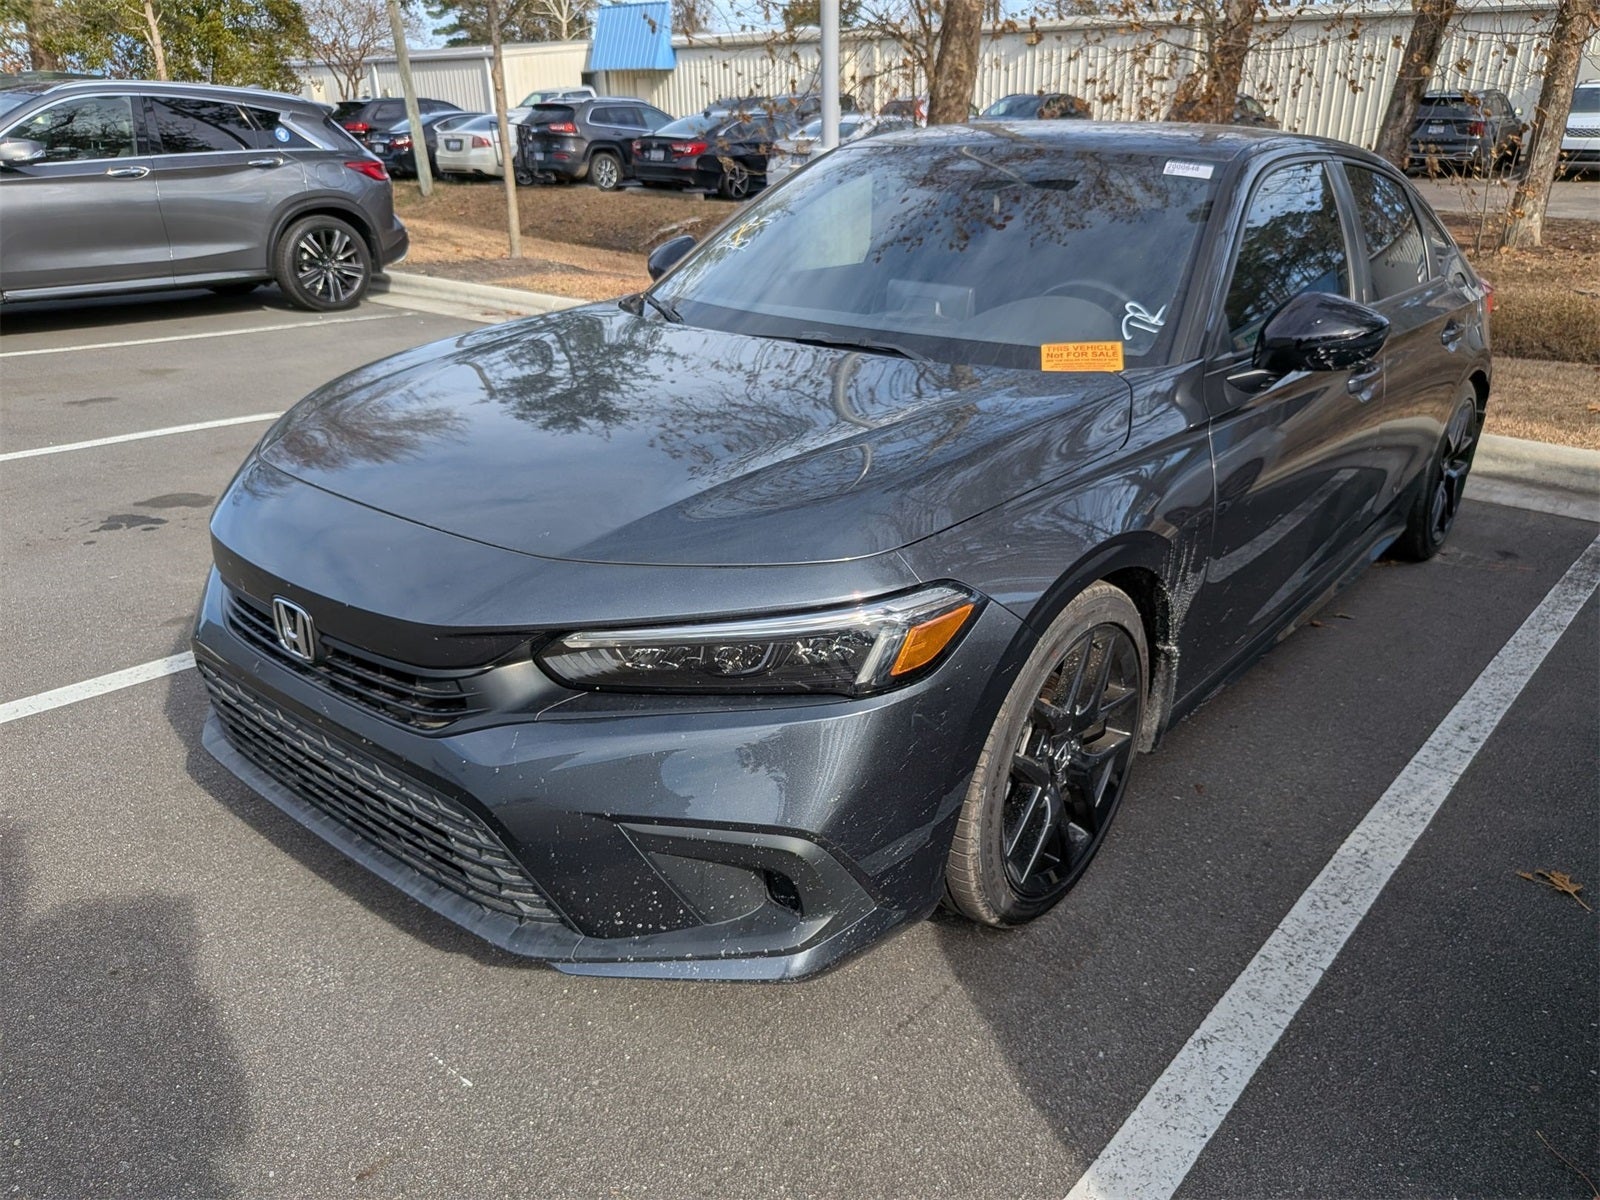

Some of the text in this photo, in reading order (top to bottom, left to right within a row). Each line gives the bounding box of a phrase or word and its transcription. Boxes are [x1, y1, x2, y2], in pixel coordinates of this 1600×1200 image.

[1047, 344, 1118, 353] THIS VEHICLE
[1066, 351, 1089, 359] FOR
